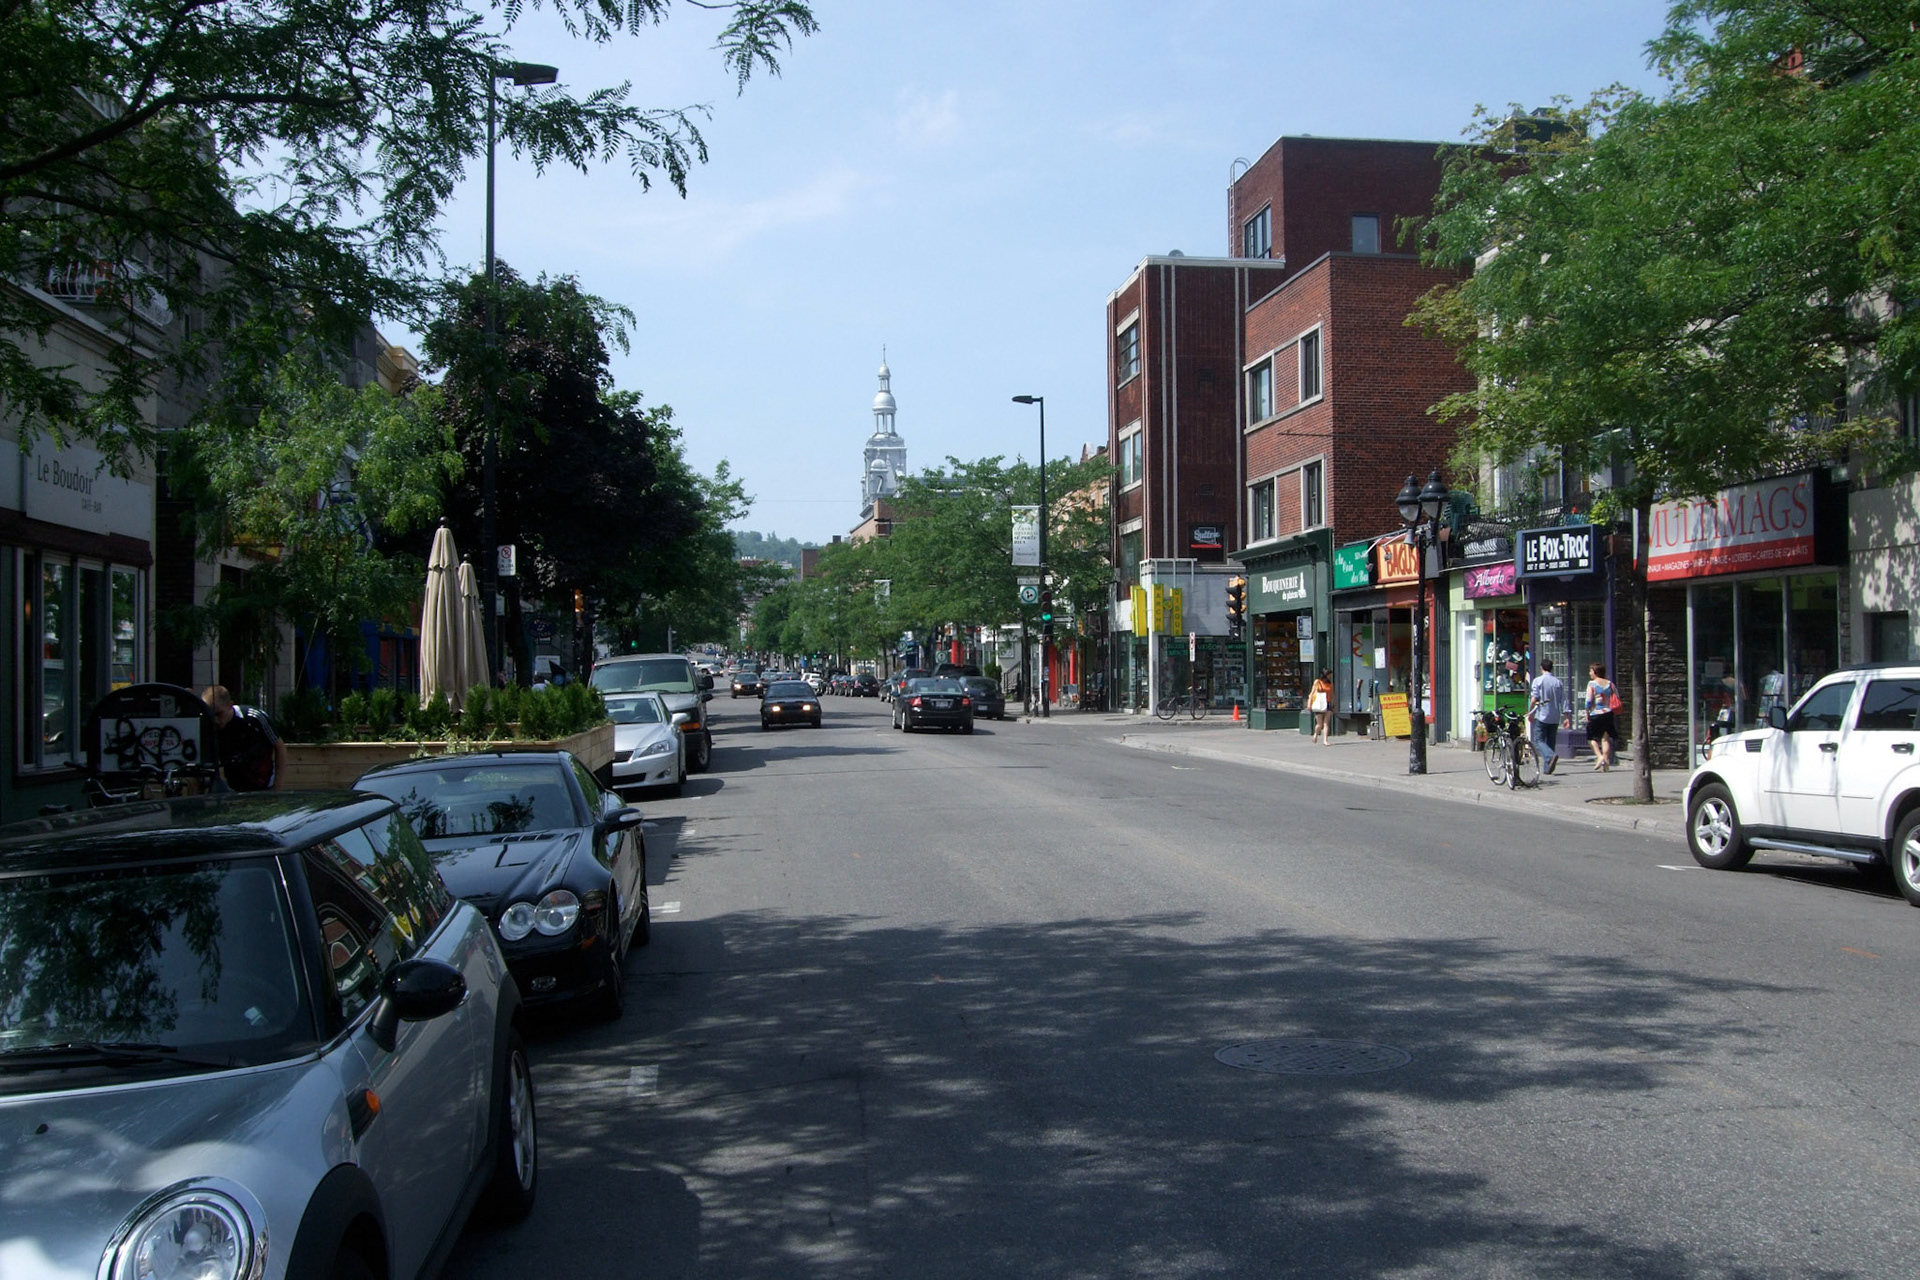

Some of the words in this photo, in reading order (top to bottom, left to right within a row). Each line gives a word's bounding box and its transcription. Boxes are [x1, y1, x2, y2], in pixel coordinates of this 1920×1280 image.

[37, 455, 49, 482] Le
[53, 459, 93, 495] Boudoir
[1526, 540, 1537, 562] LE
[1775, 548, 1782, 558] DE
[1262, 576, 1298, 594] BOUQUINERIE
[1474, 569, 1504, 587] Alberto
